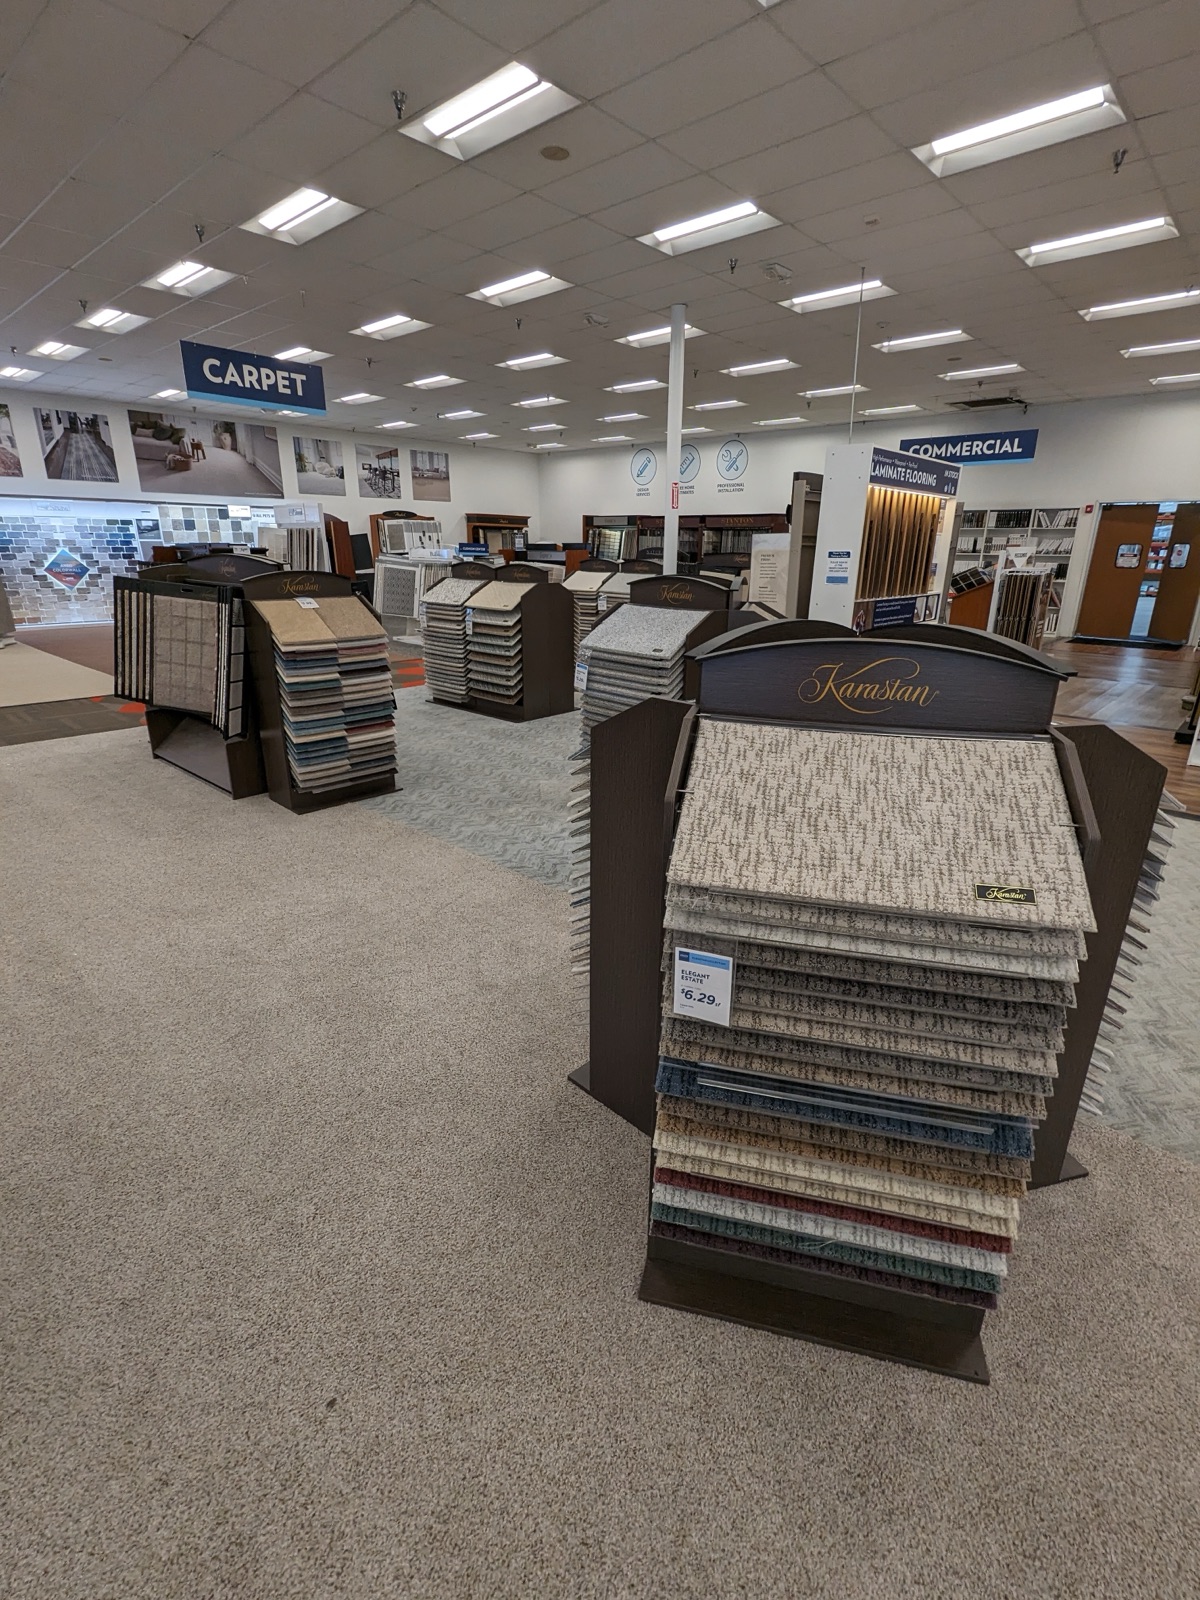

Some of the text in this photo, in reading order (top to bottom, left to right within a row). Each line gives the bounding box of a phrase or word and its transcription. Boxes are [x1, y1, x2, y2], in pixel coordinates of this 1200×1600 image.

[202, 357, 306, 397] CARPET
[908, 438, 1022, 458] COMMERCIAL
[871, 462, 937, 487] LAMINATE FLOORING
[657, 582, 695, 605] Karastan
[798, 657, 940, 714] Karastan
[986, 887, 1027, 901] Karastan
[681, 969, 710, 980] ELEGANT
[681, 974, 704, 985] ESTATE
